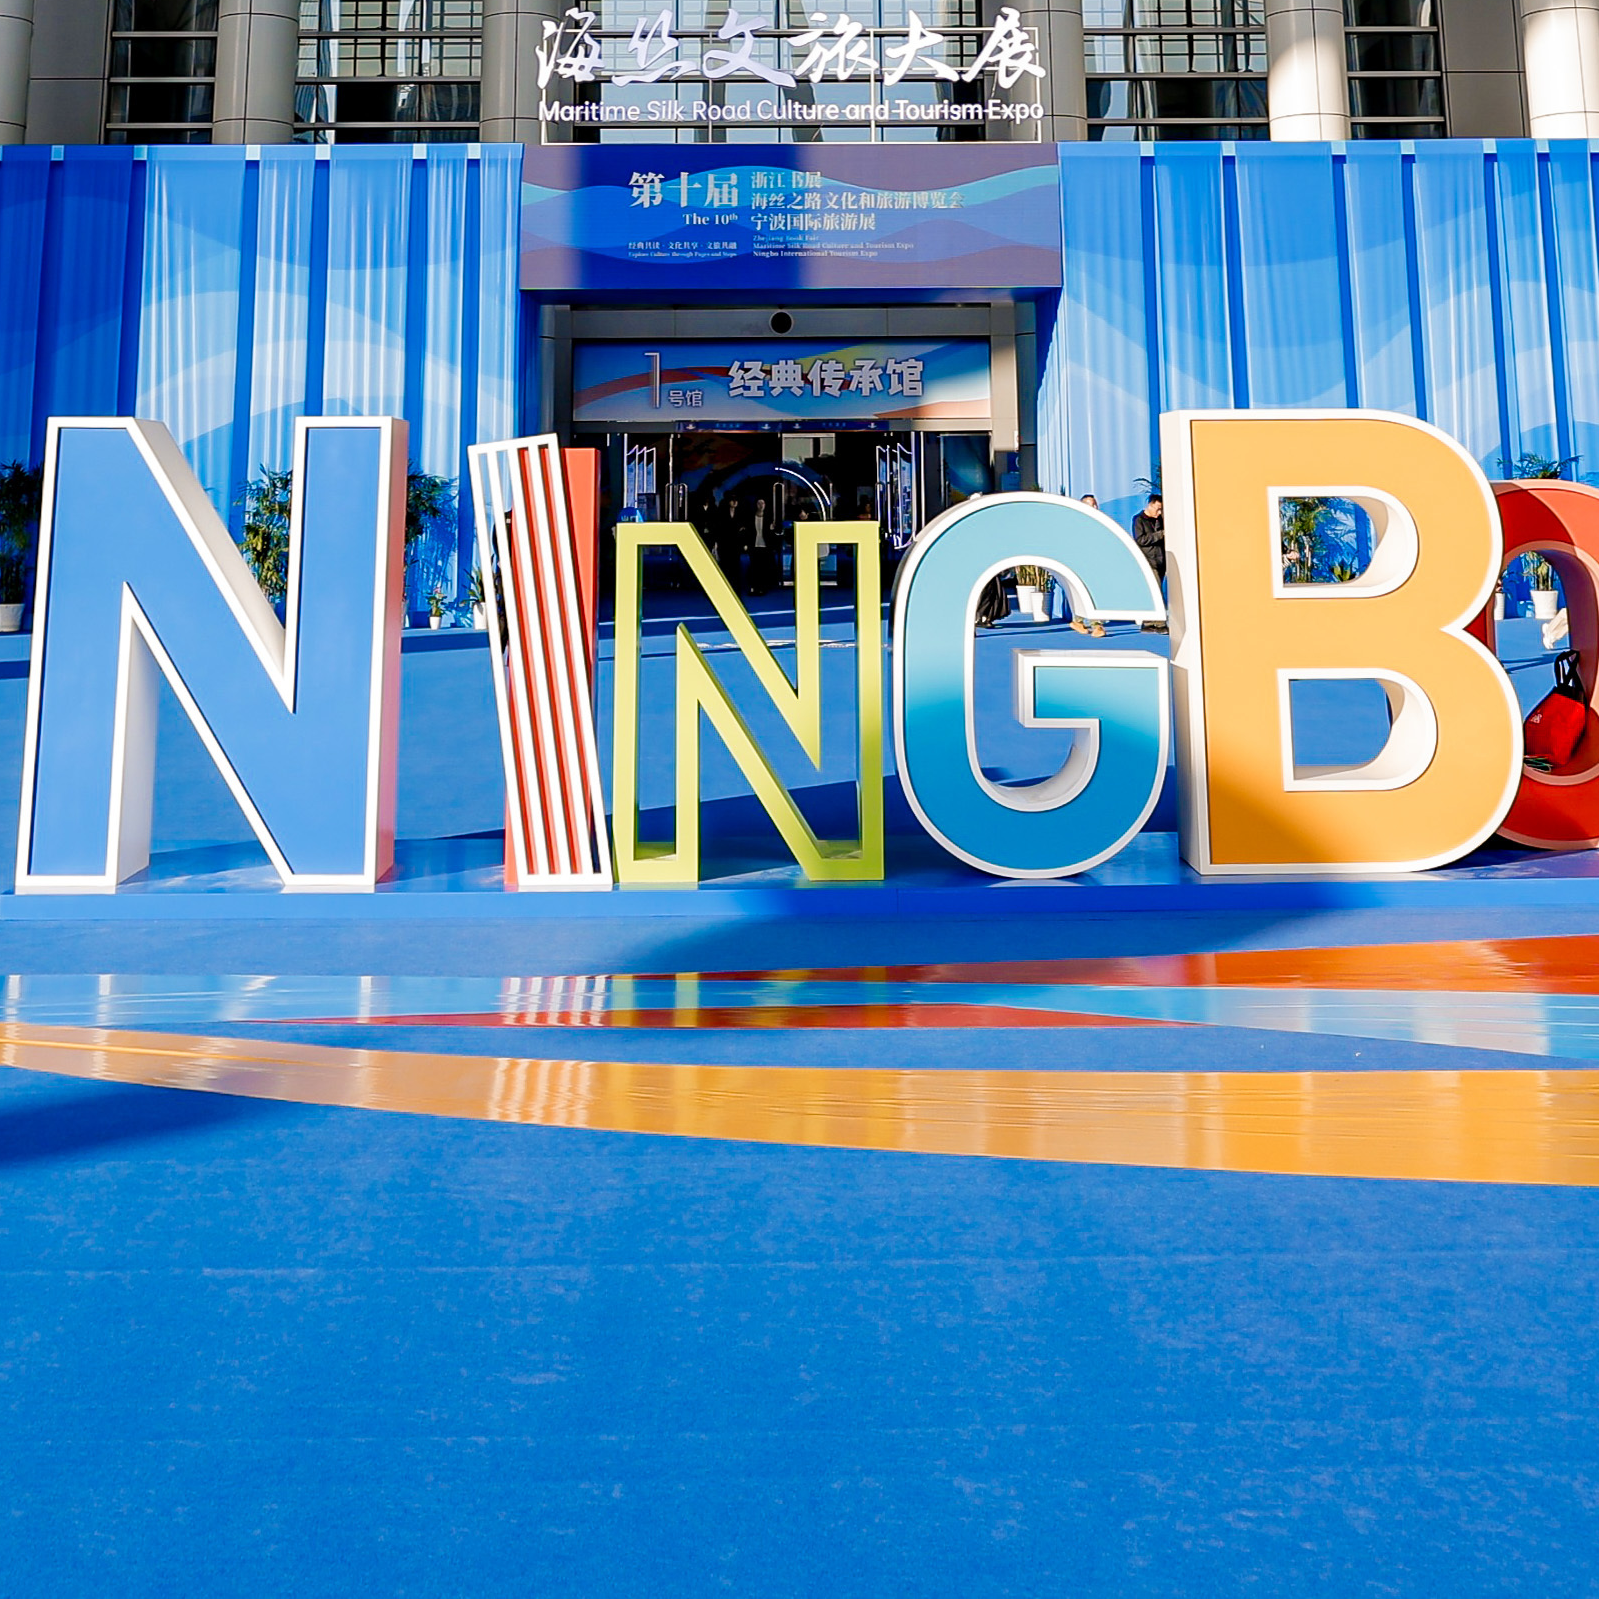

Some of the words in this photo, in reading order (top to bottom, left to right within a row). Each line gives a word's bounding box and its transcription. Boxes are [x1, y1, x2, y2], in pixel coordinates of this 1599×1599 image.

[536, 6, 1047, 89] 海丝文旅大展
[539, 99, 641, 121] Maritime
[647, 99, 685, 121] Silk
[693, 99, 751, 121] Road
[756, 99, 838, 121] Culture
[846, 99, 889, 121] and
[894, 99, 984, 121] Tourism
[988, 100, 1044, 124] Expo
[628, 172, 738, 208] 第十届
[751, 171, 822, 189] 浙江书展
[751, 192, 965, 210] 海丝之路文化和旅游博览会
[682, 213, 709, 225] The
[714, 213, 738, 225] 10th
[751, 212, 877, 231] 宁波国际旅游展
[729, 358, 923, 398] 经典传承馆
